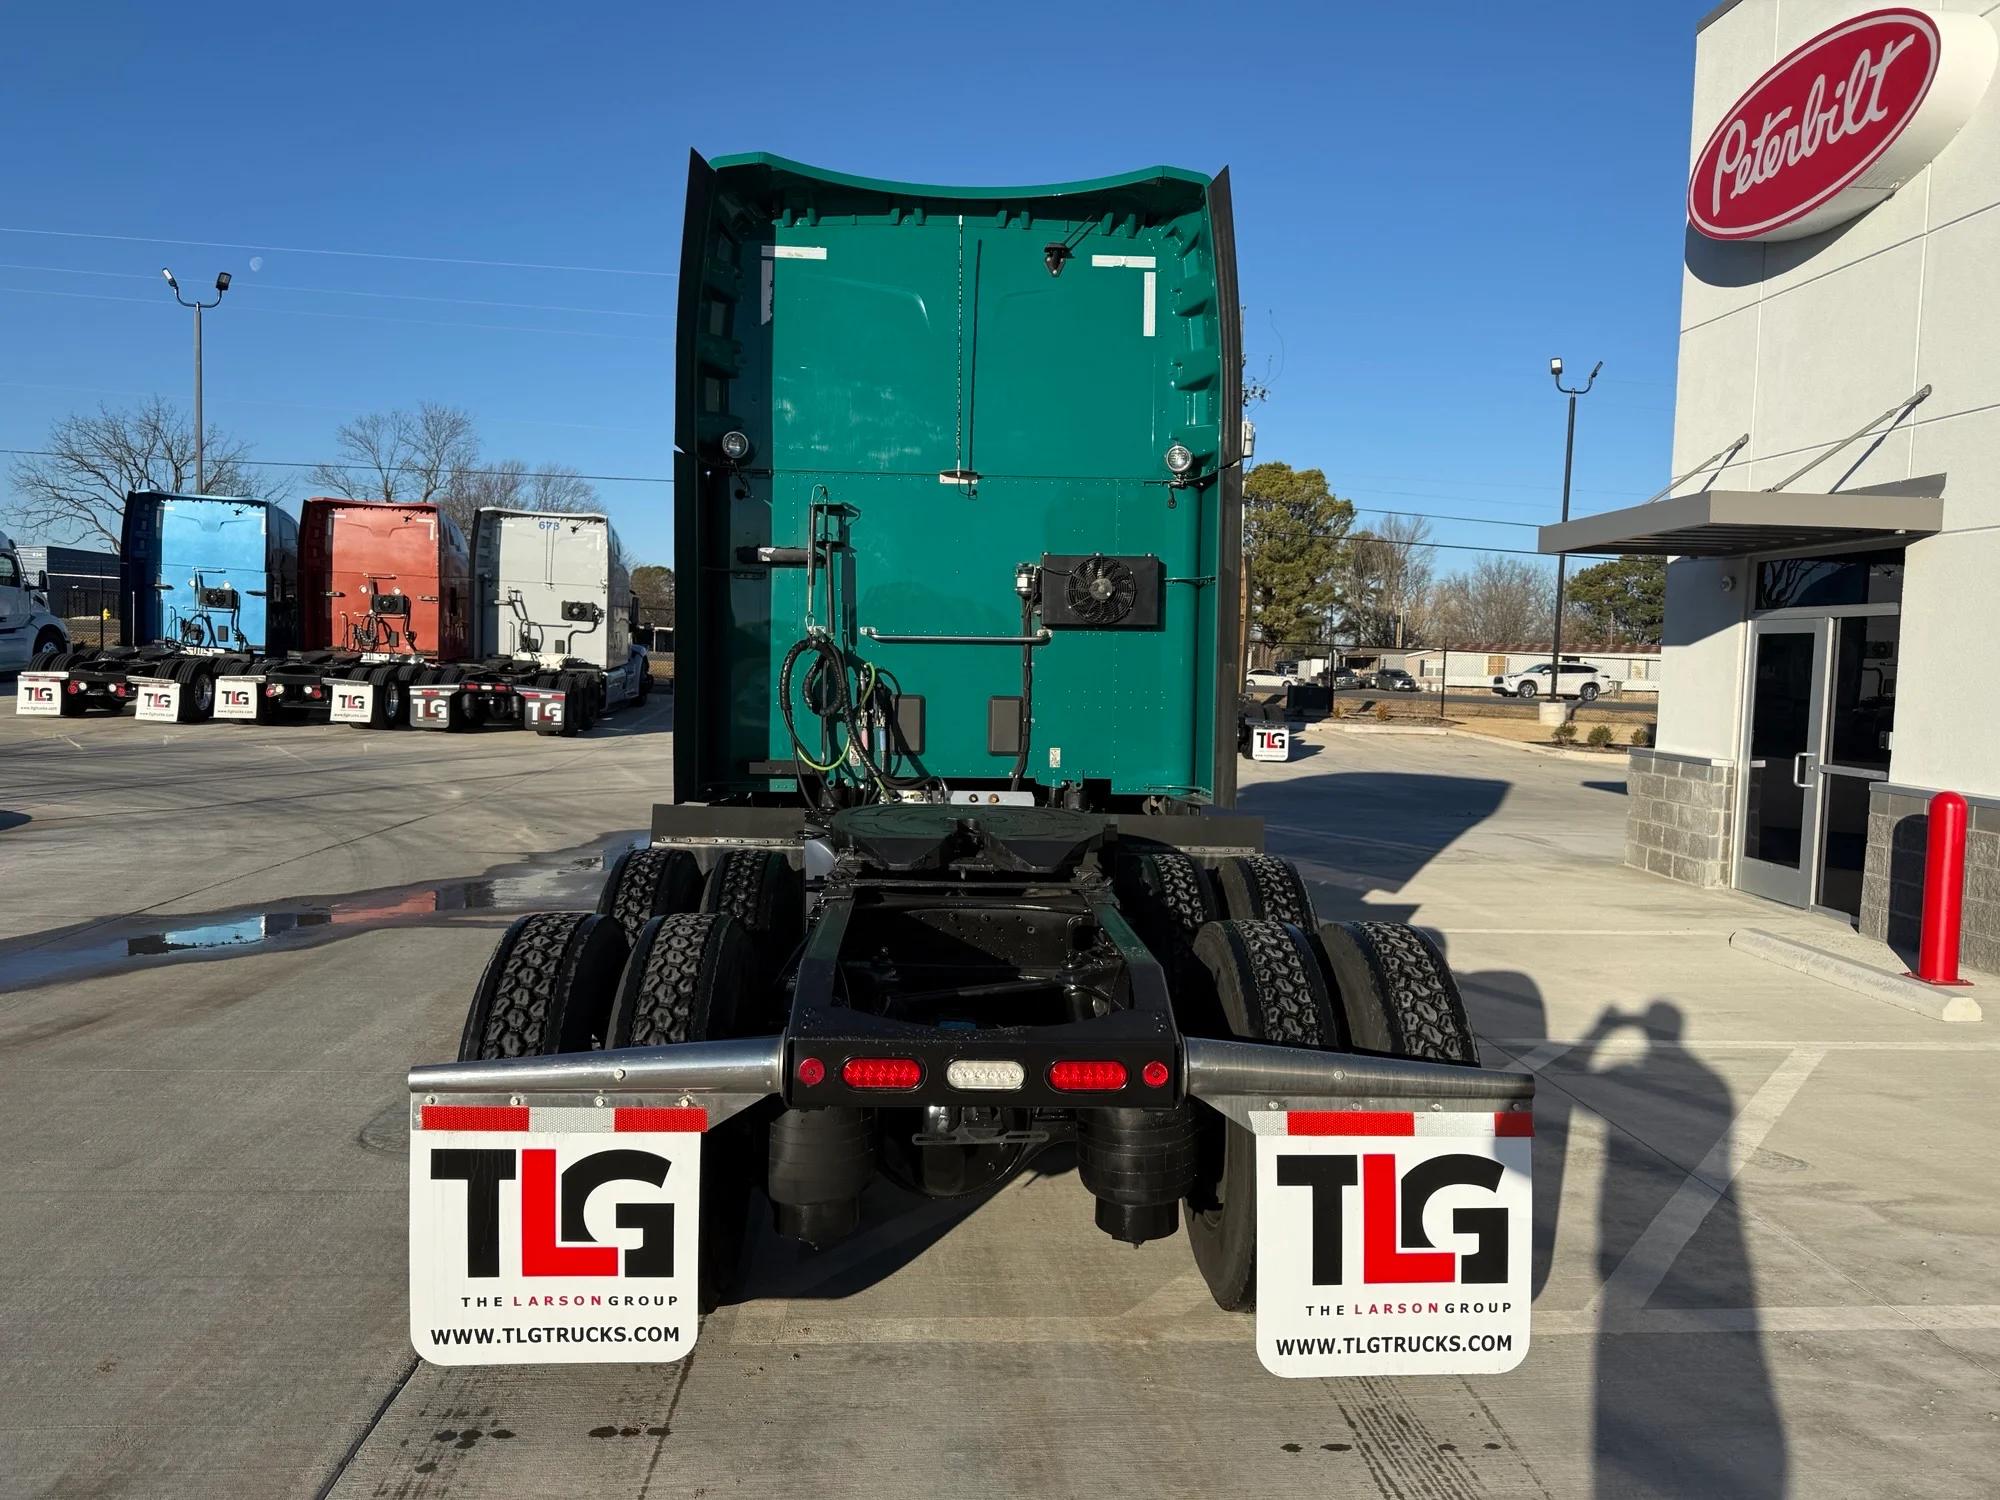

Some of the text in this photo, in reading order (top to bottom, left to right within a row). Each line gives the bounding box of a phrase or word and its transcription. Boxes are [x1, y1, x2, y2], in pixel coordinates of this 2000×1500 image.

[1713, 34, 1915, 217] Peterbilt
[539, 521, 560, 530] 673
[24, 687, 53, 701] TLG
[144, 693, 171, 708] TLG
[222, 691, 249, 705] TLG
[338, 695, 365, 709] TLG
[413, 698, 447, 718] TLG
[528, 701, 562, 721] TLG
[1256, 732, 1285, 748] TLG
[431, 1149, 675, 1278] TLG
[1277, 1154, 1509, 1285] TLG
[461, 1295, 678, 1308] THE LARSON GROUP
[1305, 1302, 1511, 1316] THE LARSON GROUP
[431, 1327, 679, 1345] WWW.TLGTRUCKS.COM
[1276, 1335, 1511, 1356] WWW.TLGTRUCKS.COM
